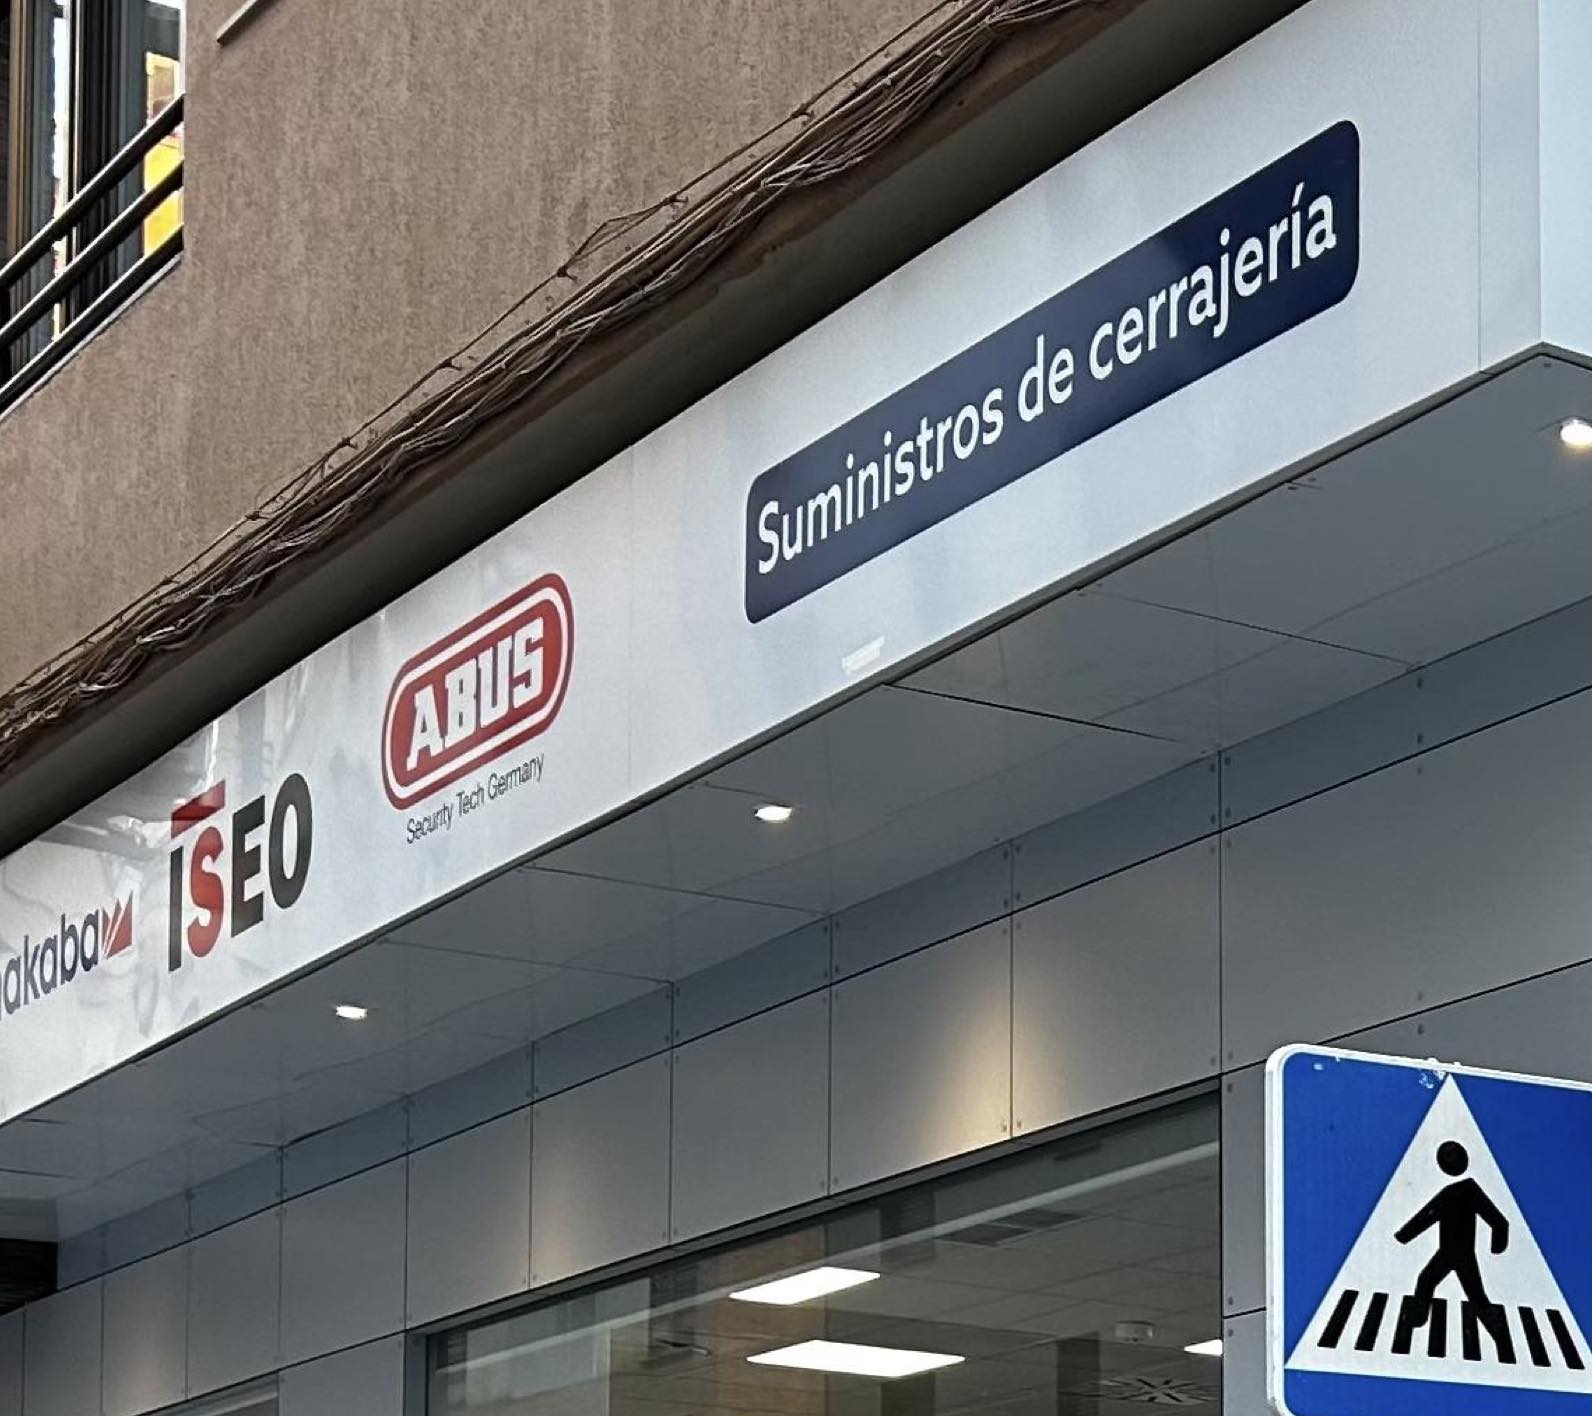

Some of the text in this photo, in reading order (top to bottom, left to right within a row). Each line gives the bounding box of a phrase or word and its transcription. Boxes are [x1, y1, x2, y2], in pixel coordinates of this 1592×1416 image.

[757, 182, 1337, 574] Suministros de cerrajería
[406, 616, 545, 772] ABUS
[168, 773, 313, 972] ISEO
[406, 752, 545, 844] Security Tech Germany
[0, 909, 100, 1019] akaba
